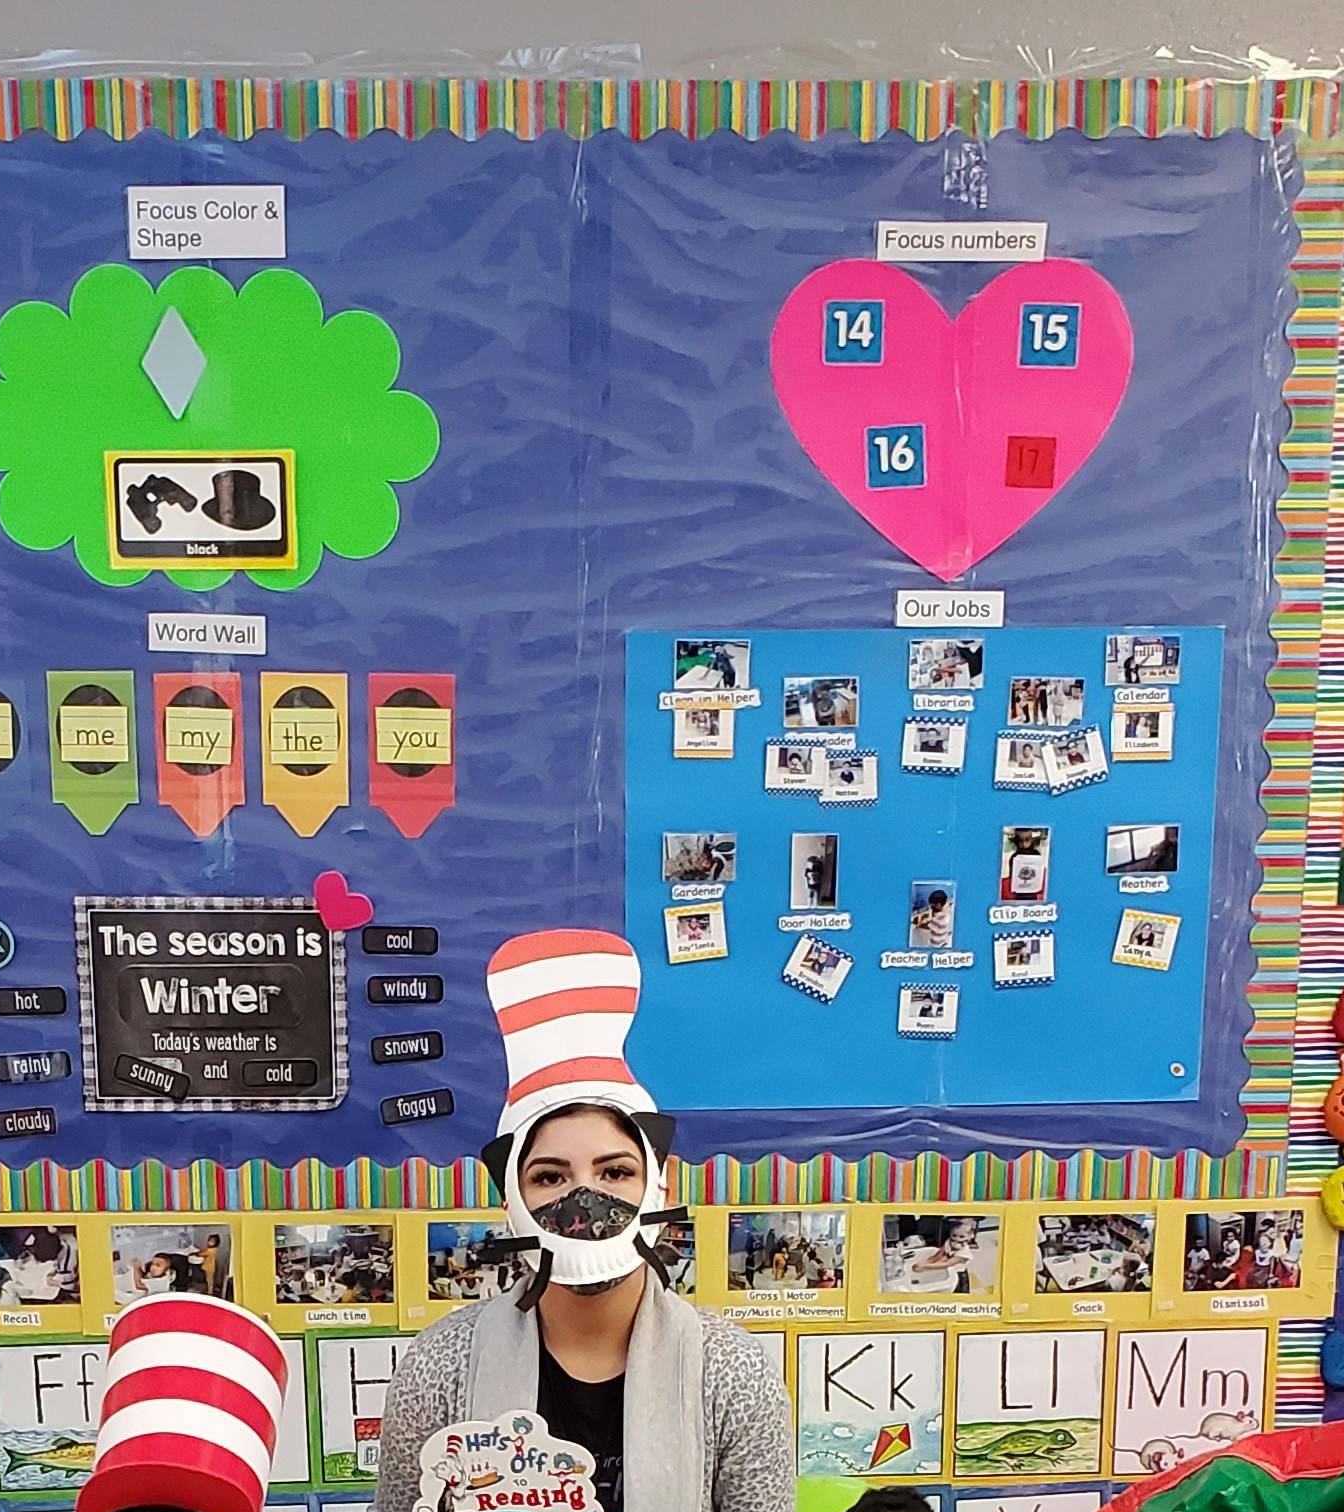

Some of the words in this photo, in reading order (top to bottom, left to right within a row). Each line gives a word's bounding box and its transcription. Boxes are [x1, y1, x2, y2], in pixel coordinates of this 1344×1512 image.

[136, 201, 197, 220] Focus
[204, 201, 257, 221] Color
[264, 201, 278, 220] &
[137, 230, 202, 251] Shape
[885, 230, 946, 250] Focus
[951, 230, 1037, 250] numbers
[834, 310, 874, 348] 14
[1029, 313, 1068, 351] 15
[875, 436, 915, 472] 16
[186, 544, 219, 555] black
[904, 600, 940, 618] Our
[945, 600, 991, 619] Jobs
[155, 624, 207, 643] Word
[213, 626, 256, 645] Wall
[916, 697, 971, 708] Librarian
[1117, 690, 1166, 700] Calendar
[76, 728, 115, 747] me
[180, 728, 220, 759] my
[282, 723, 323, 753] the
[393, 729, 438, 759] you
[674, 886, 722, 897] Gardener
[781, 918, 806, 928] Door
[810, 918, 848, 928] Holder
[992, 909, 1018, 920] Clip
[1023, 907, 1054, 918] Board
[99, 925, 157, 957] The
[169, 929, 286, 957] season
[297, 928, 322, 956] is
[386, 932, 413, 949] cool
[885, 953, 927, 964] Teacher
[935, 954, 972, 966] Helper
[140, 977, 282, 1015] Winter
[383, 978, 427, 1000] windy
[15, 991, 40, 1011] hot
[152, 1033, 201, 1052] Today's
[205, 1034, 260, 1052] weather
[265, 1035, 276, 1051] is
[384, 1037, 429, 1058] snowy
[12, 1056, 51, 1076] rainy
[203, 1060, 228, 1079] and
[266, 1064, 293, 1083] cold
[130, 1061, 176, 1093] sunny
[395, 1094, 437, 1118] foggy
[5, 1108, 51, 1132] cloudy
[749, 1291, 781, 1300] Gross
[787, 1291, 817, 1300] Motor
[1212, 1297, 1265, 1309] Dismissal
[308, 1310, 341, 1322] Lunch
[346, 1310, 367, 1321] time
[723, 1307, 782, 1317] Play/Music
[798, 1307, 844, 1317] Movement
[1073, 1303, 1104, 1313] Snack
[3, 1312, 39, 1325] Recall
[466, 1426, 510, 1452] Hats
[510, 1447, 548, 1473] Off
[476, 1485, 586, 1511] Reading
